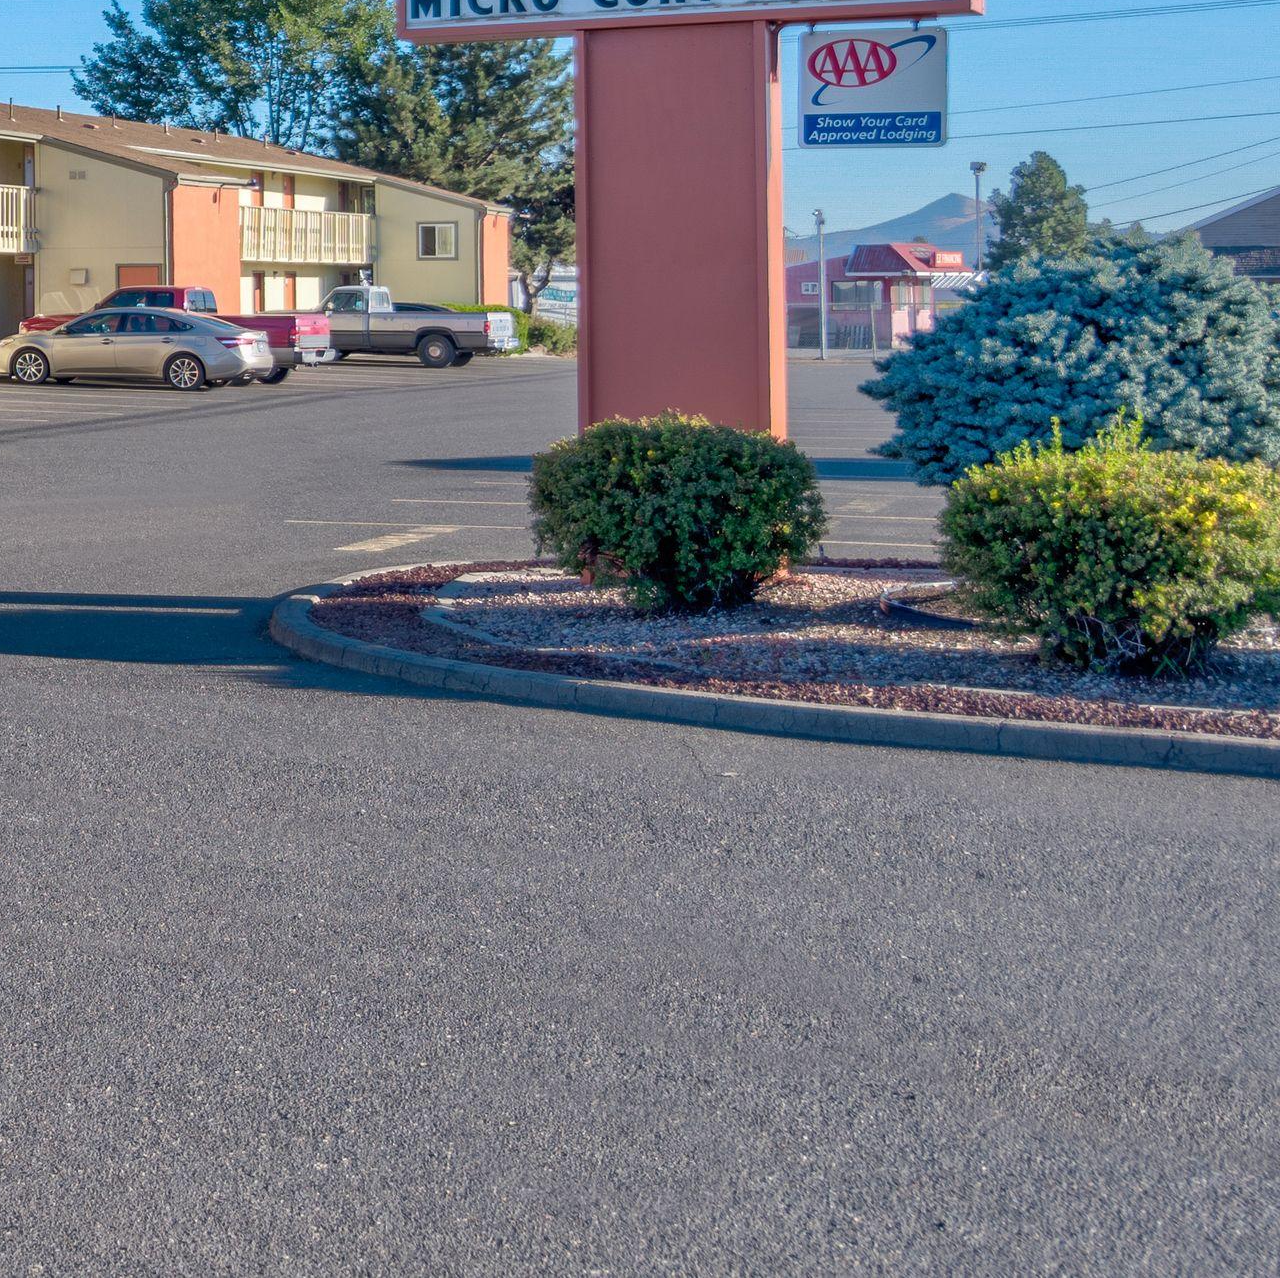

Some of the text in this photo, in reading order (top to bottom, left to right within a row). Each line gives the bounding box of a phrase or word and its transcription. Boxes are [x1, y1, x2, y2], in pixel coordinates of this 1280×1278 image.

[814, 39, 888, 87] AAA
[816, 115, 928, 128] Show Your Card
[808, 128, 937, 143] Approved Lodging
